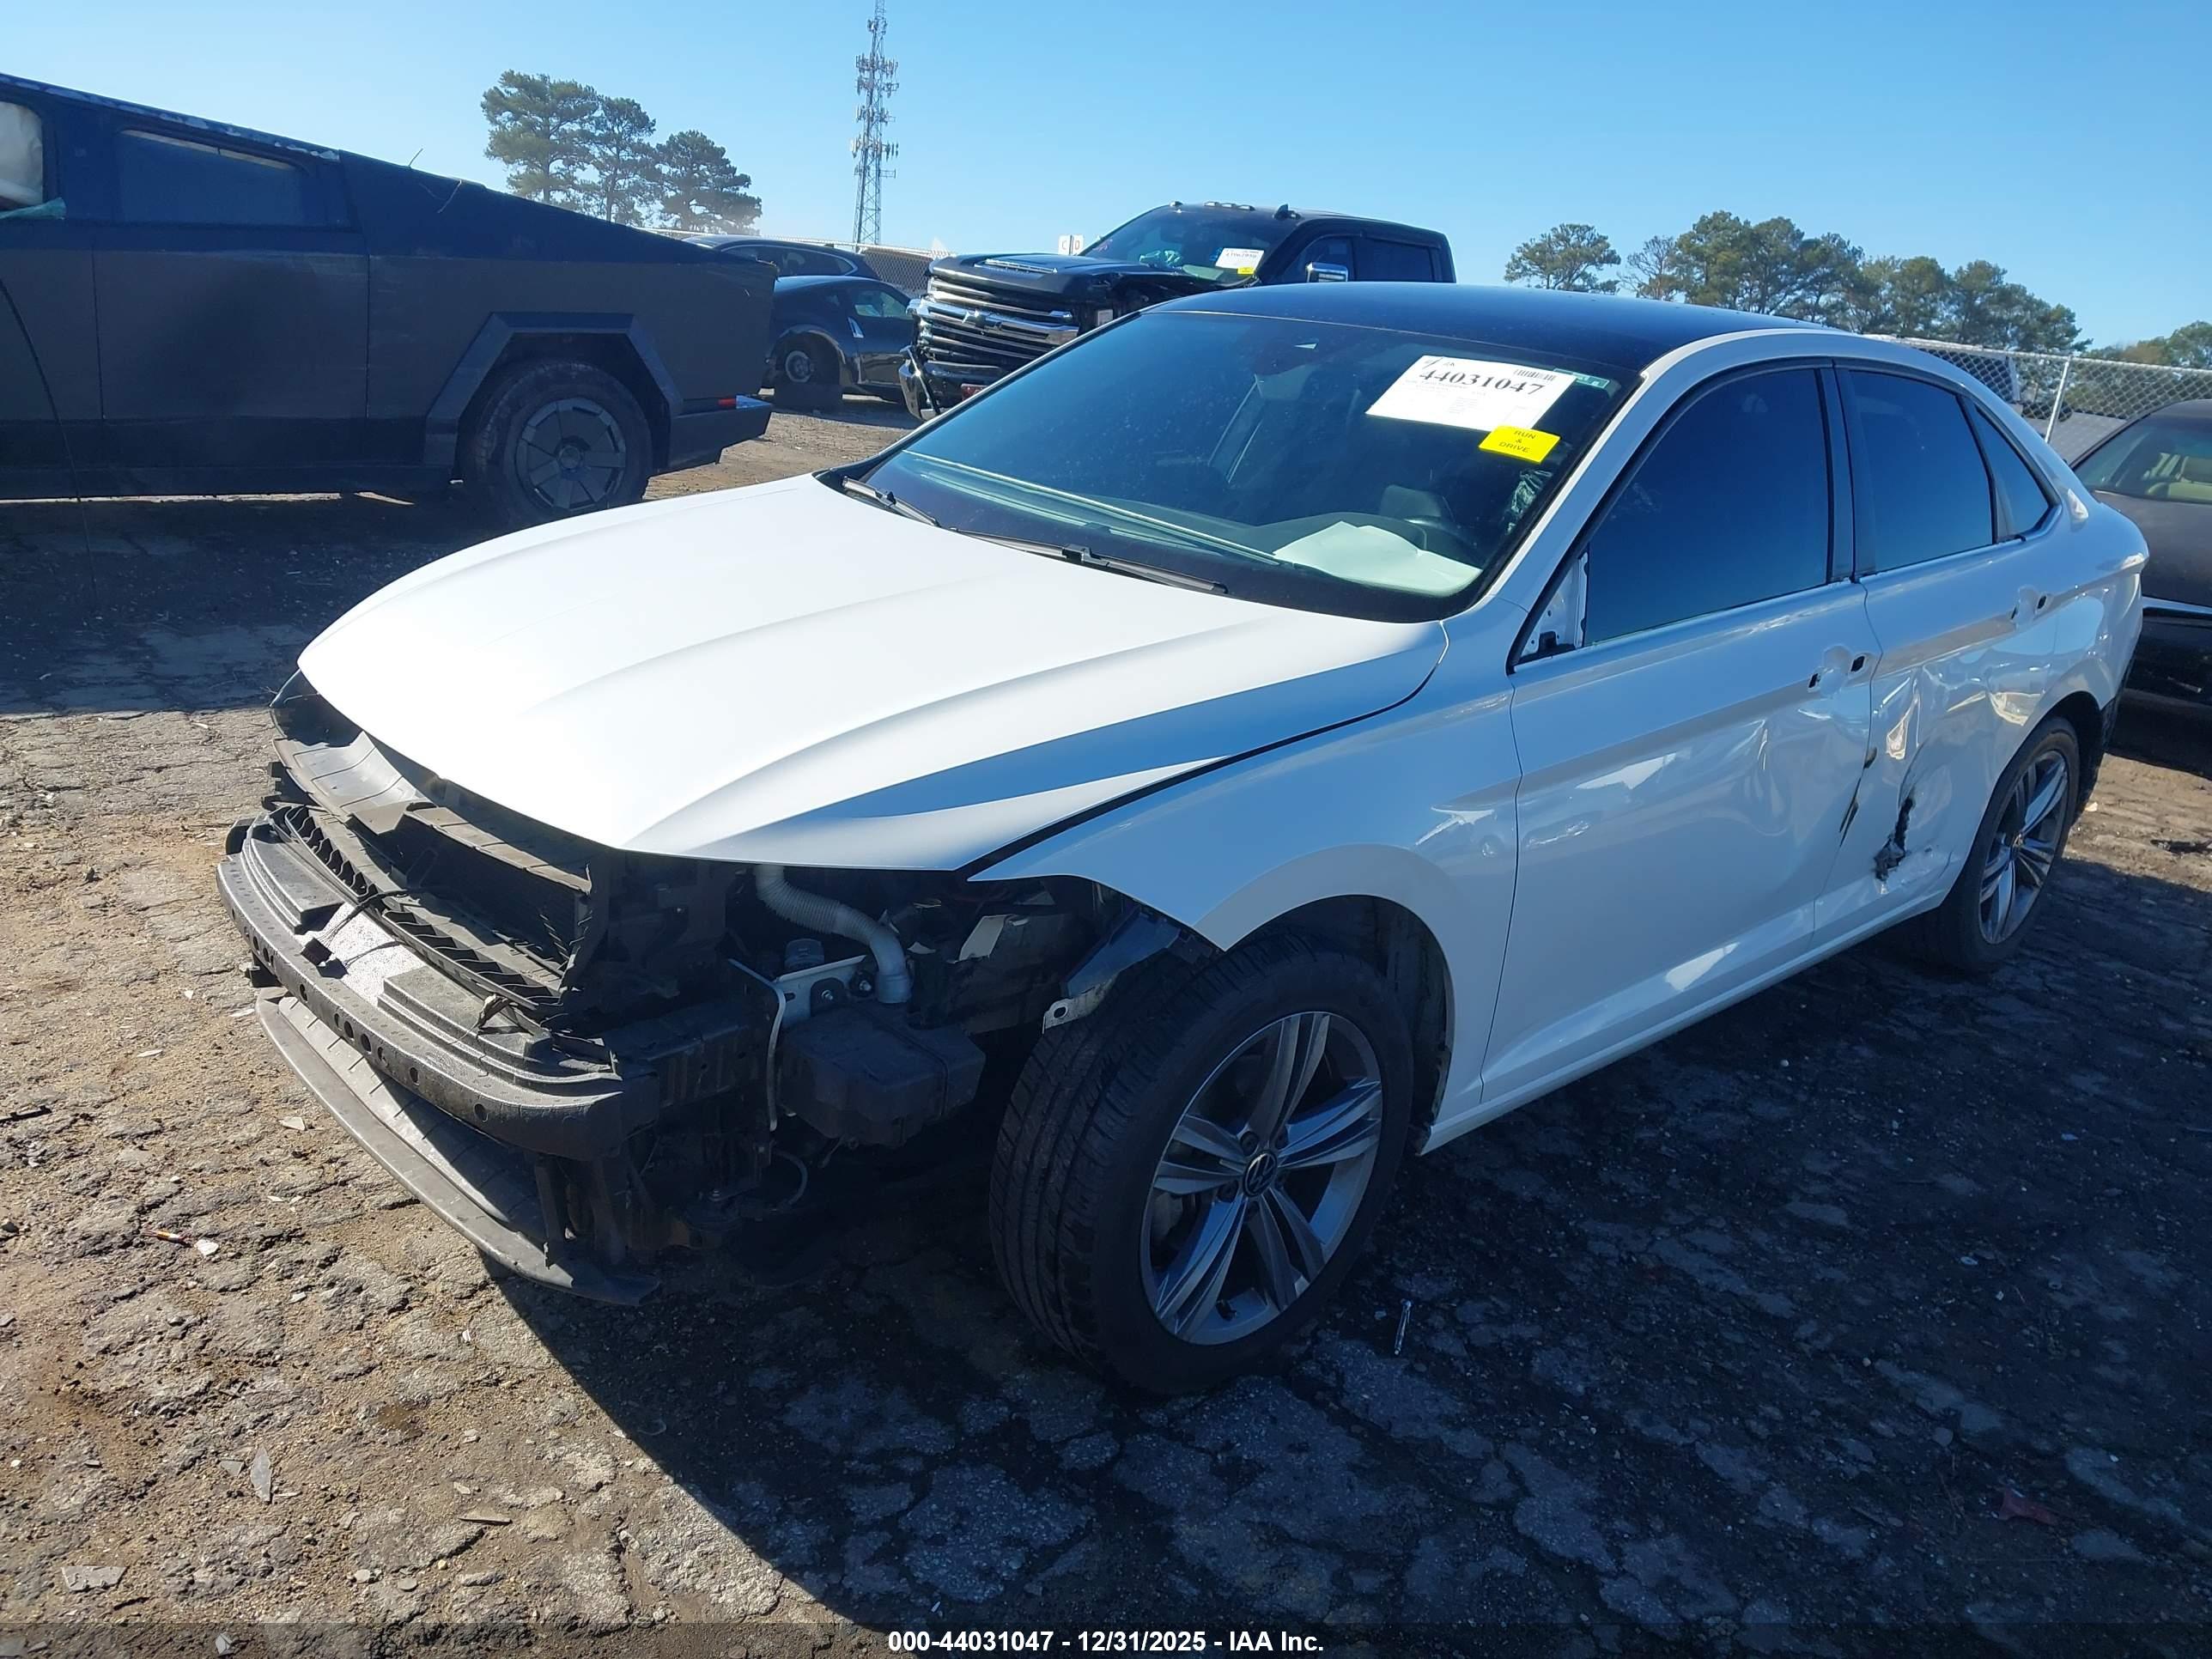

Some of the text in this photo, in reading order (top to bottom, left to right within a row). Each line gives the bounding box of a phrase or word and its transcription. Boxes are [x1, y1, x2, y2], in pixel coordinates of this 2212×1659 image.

[1419, 369, 1546, 395] 44031047
[1513, 430, 1536, 439] RUN
[1498, 441, 1530, 453] DRIVE
